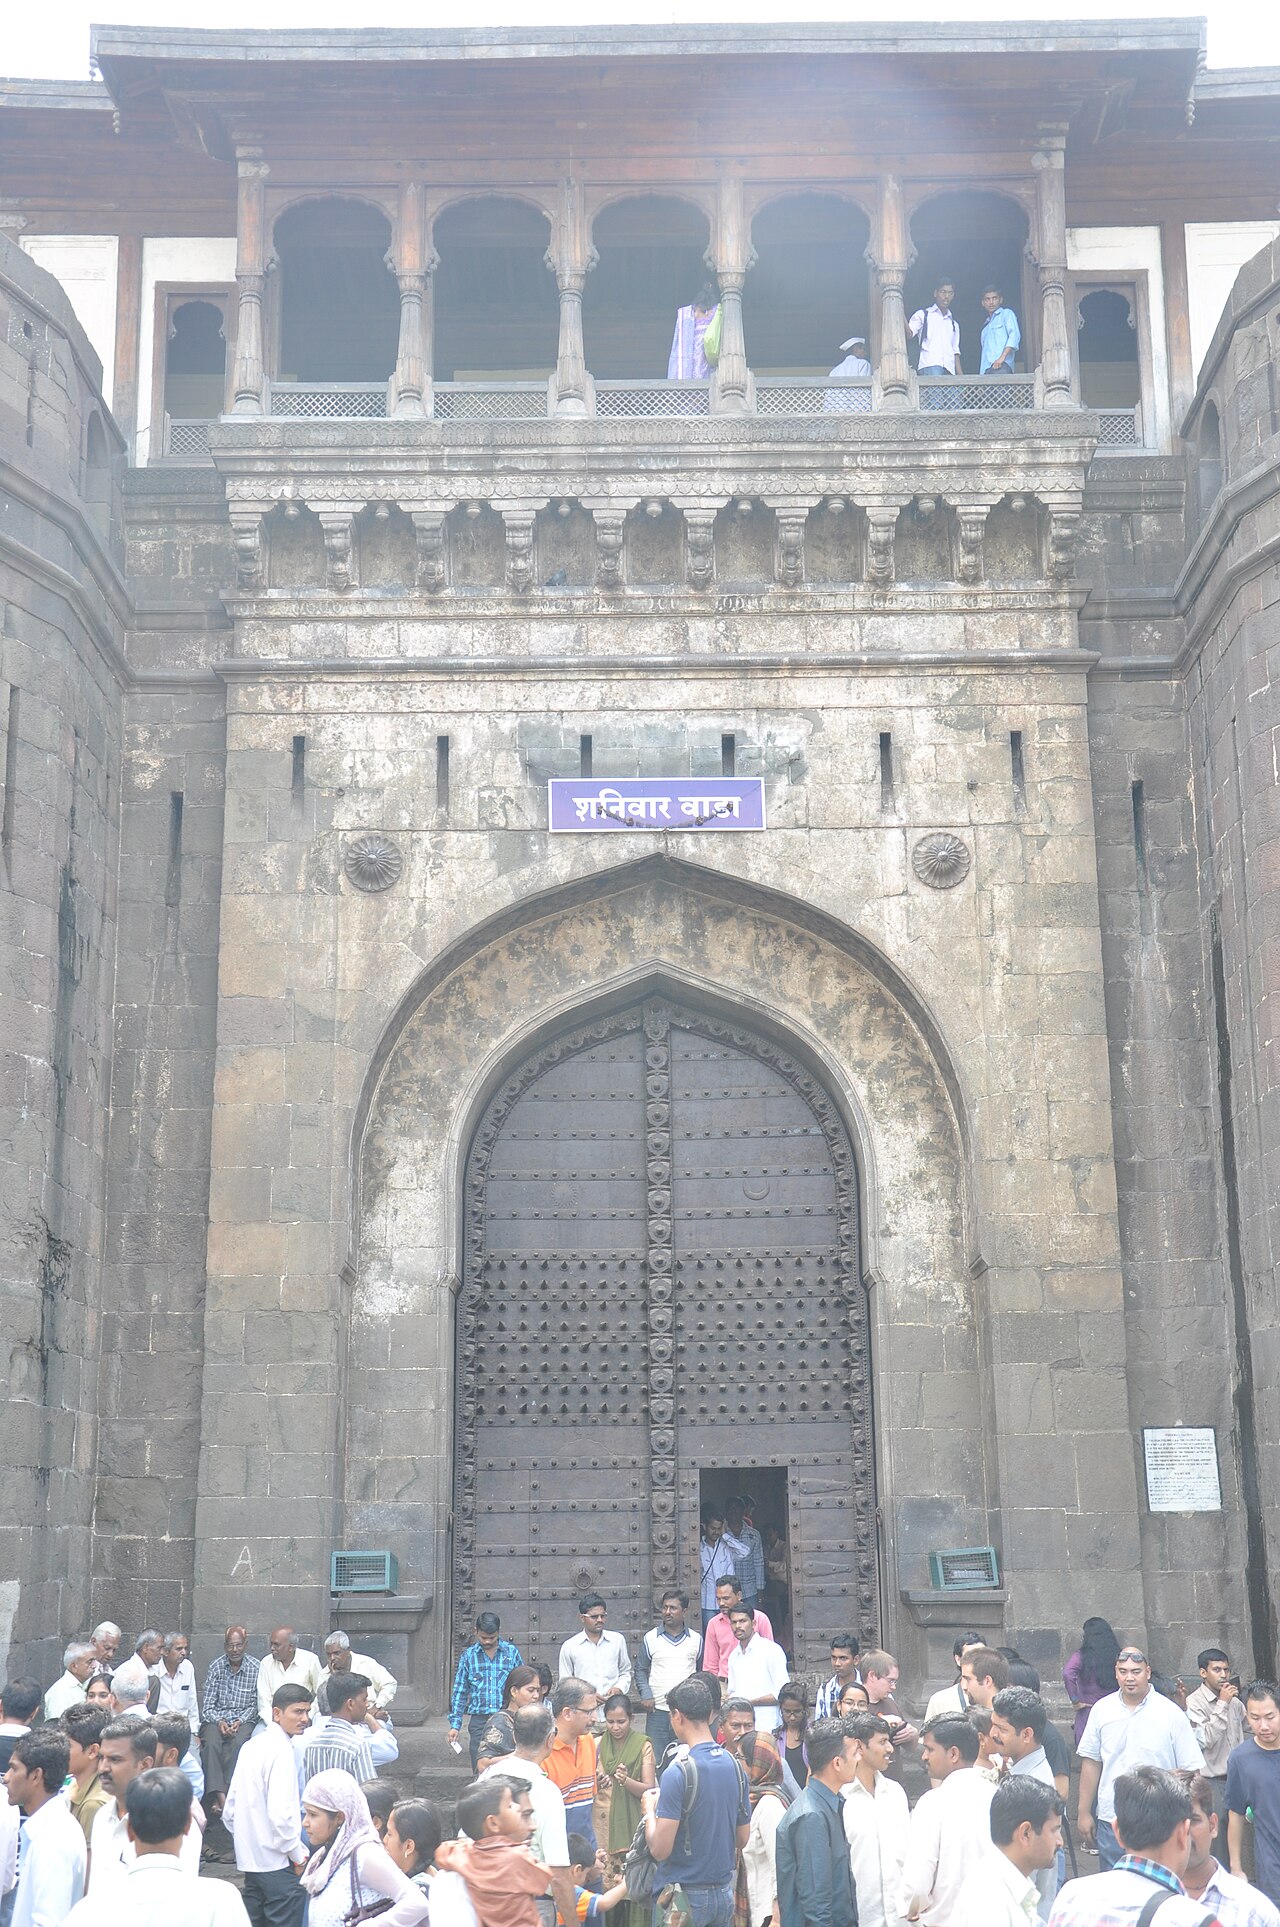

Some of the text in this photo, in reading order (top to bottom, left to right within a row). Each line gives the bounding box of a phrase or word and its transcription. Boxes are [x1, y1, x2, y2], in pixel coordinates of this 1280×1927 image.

[572, 788, 742, 822] शनिवार वाडा
[230, 1546, 254, 1579] A
